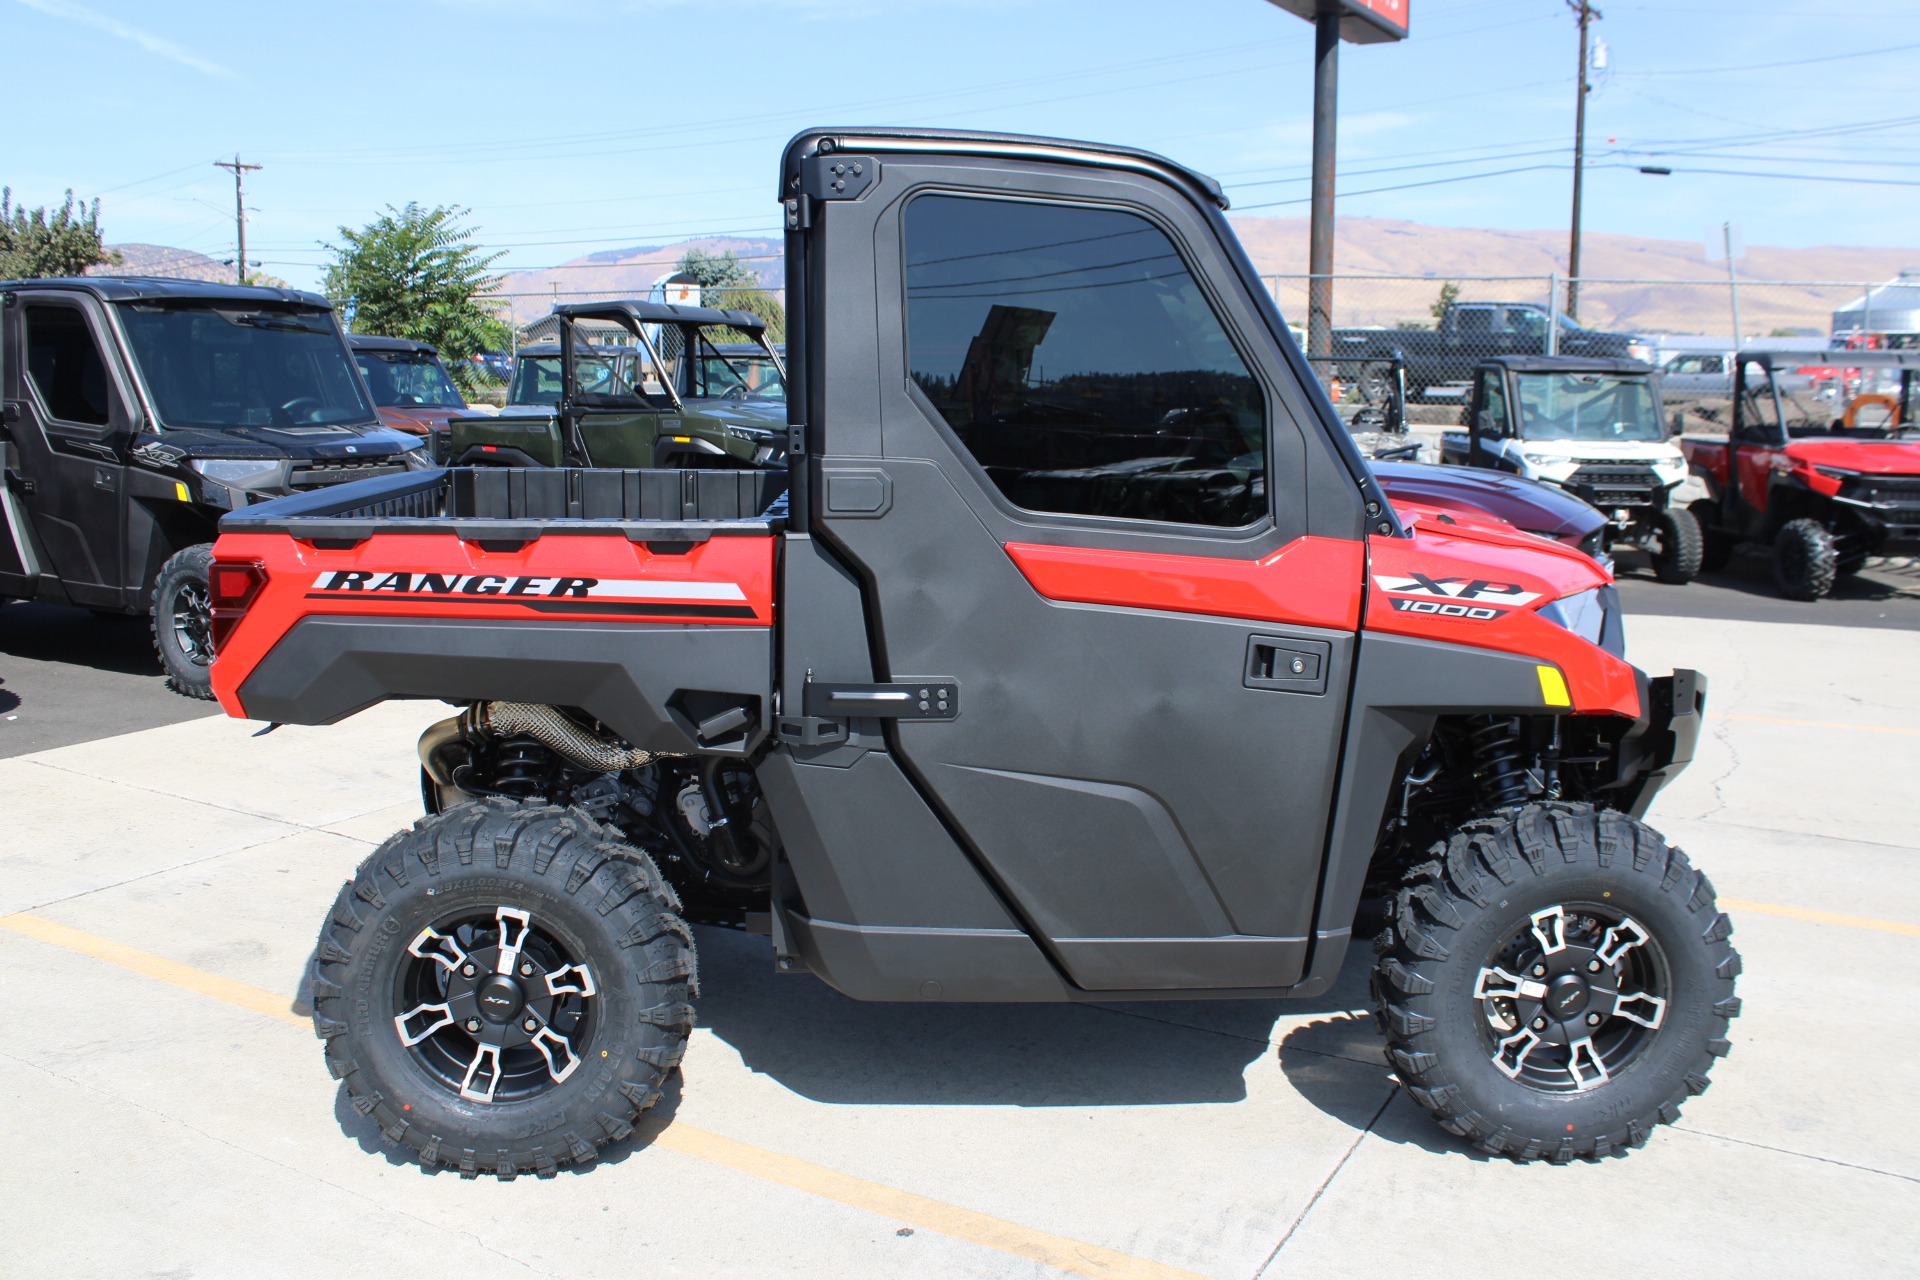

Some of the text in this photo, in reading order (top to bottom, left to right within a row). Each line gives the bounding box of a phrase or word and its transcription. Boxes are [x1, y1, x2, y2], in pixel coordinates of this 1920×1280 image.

[324, 570, 599, 598] RANGER
[1387, 571, 1526, 599] XP
[1399, 600, 1497, 620] 1000
[484, 996, 510, 1005] XP
